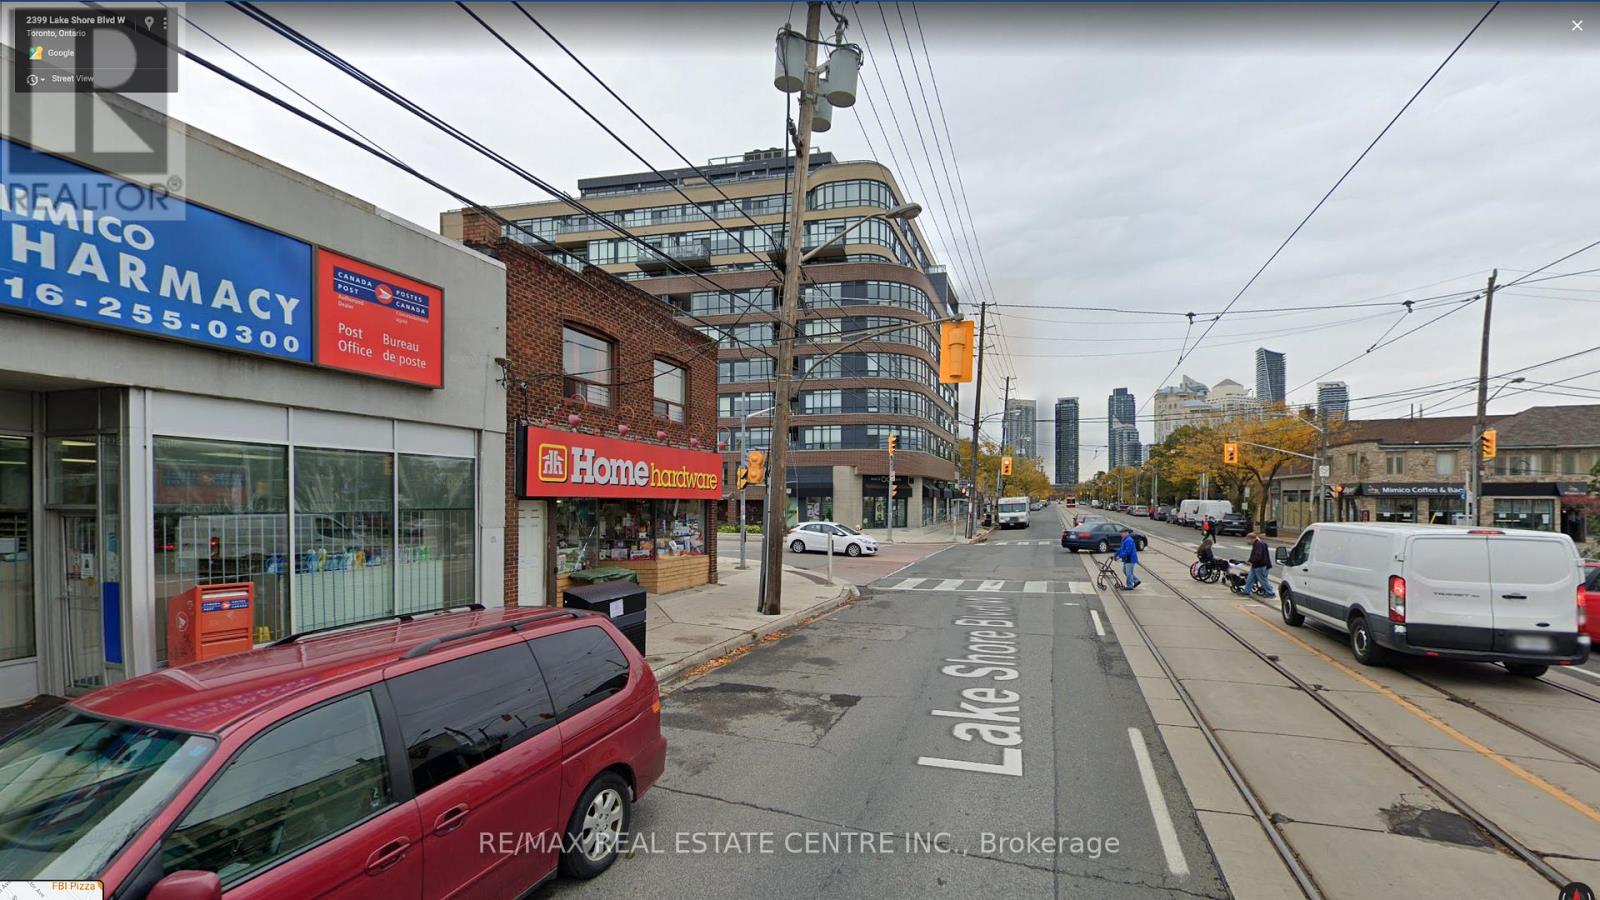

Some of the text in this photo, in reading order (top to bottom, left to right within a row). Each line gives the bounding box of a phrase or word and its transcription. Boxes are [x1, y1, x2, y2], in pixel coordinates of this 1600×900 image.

[0, 184, 155, 251] IMICO
[11, 222, 300, 326] HARMACY
[337, 271, 373, 288] CANADA
[337, 283, 359, 295] POST
[395, 289, 423, 304] POSTES
[395, 301, 426, 315] CANADA
[338, 322, 363, 340] Post
[338, 339, 373, 358] Office
[382, 333, 419, 353] Bureau
[382, 349, 427, 370] de poste
[571, 446, 718, 490] Home hardware
[1382, 486, 1411, 494] Mimico
[1411, 486, 1438, 494] Coffee
[1439, 486, 1446, 494] &
